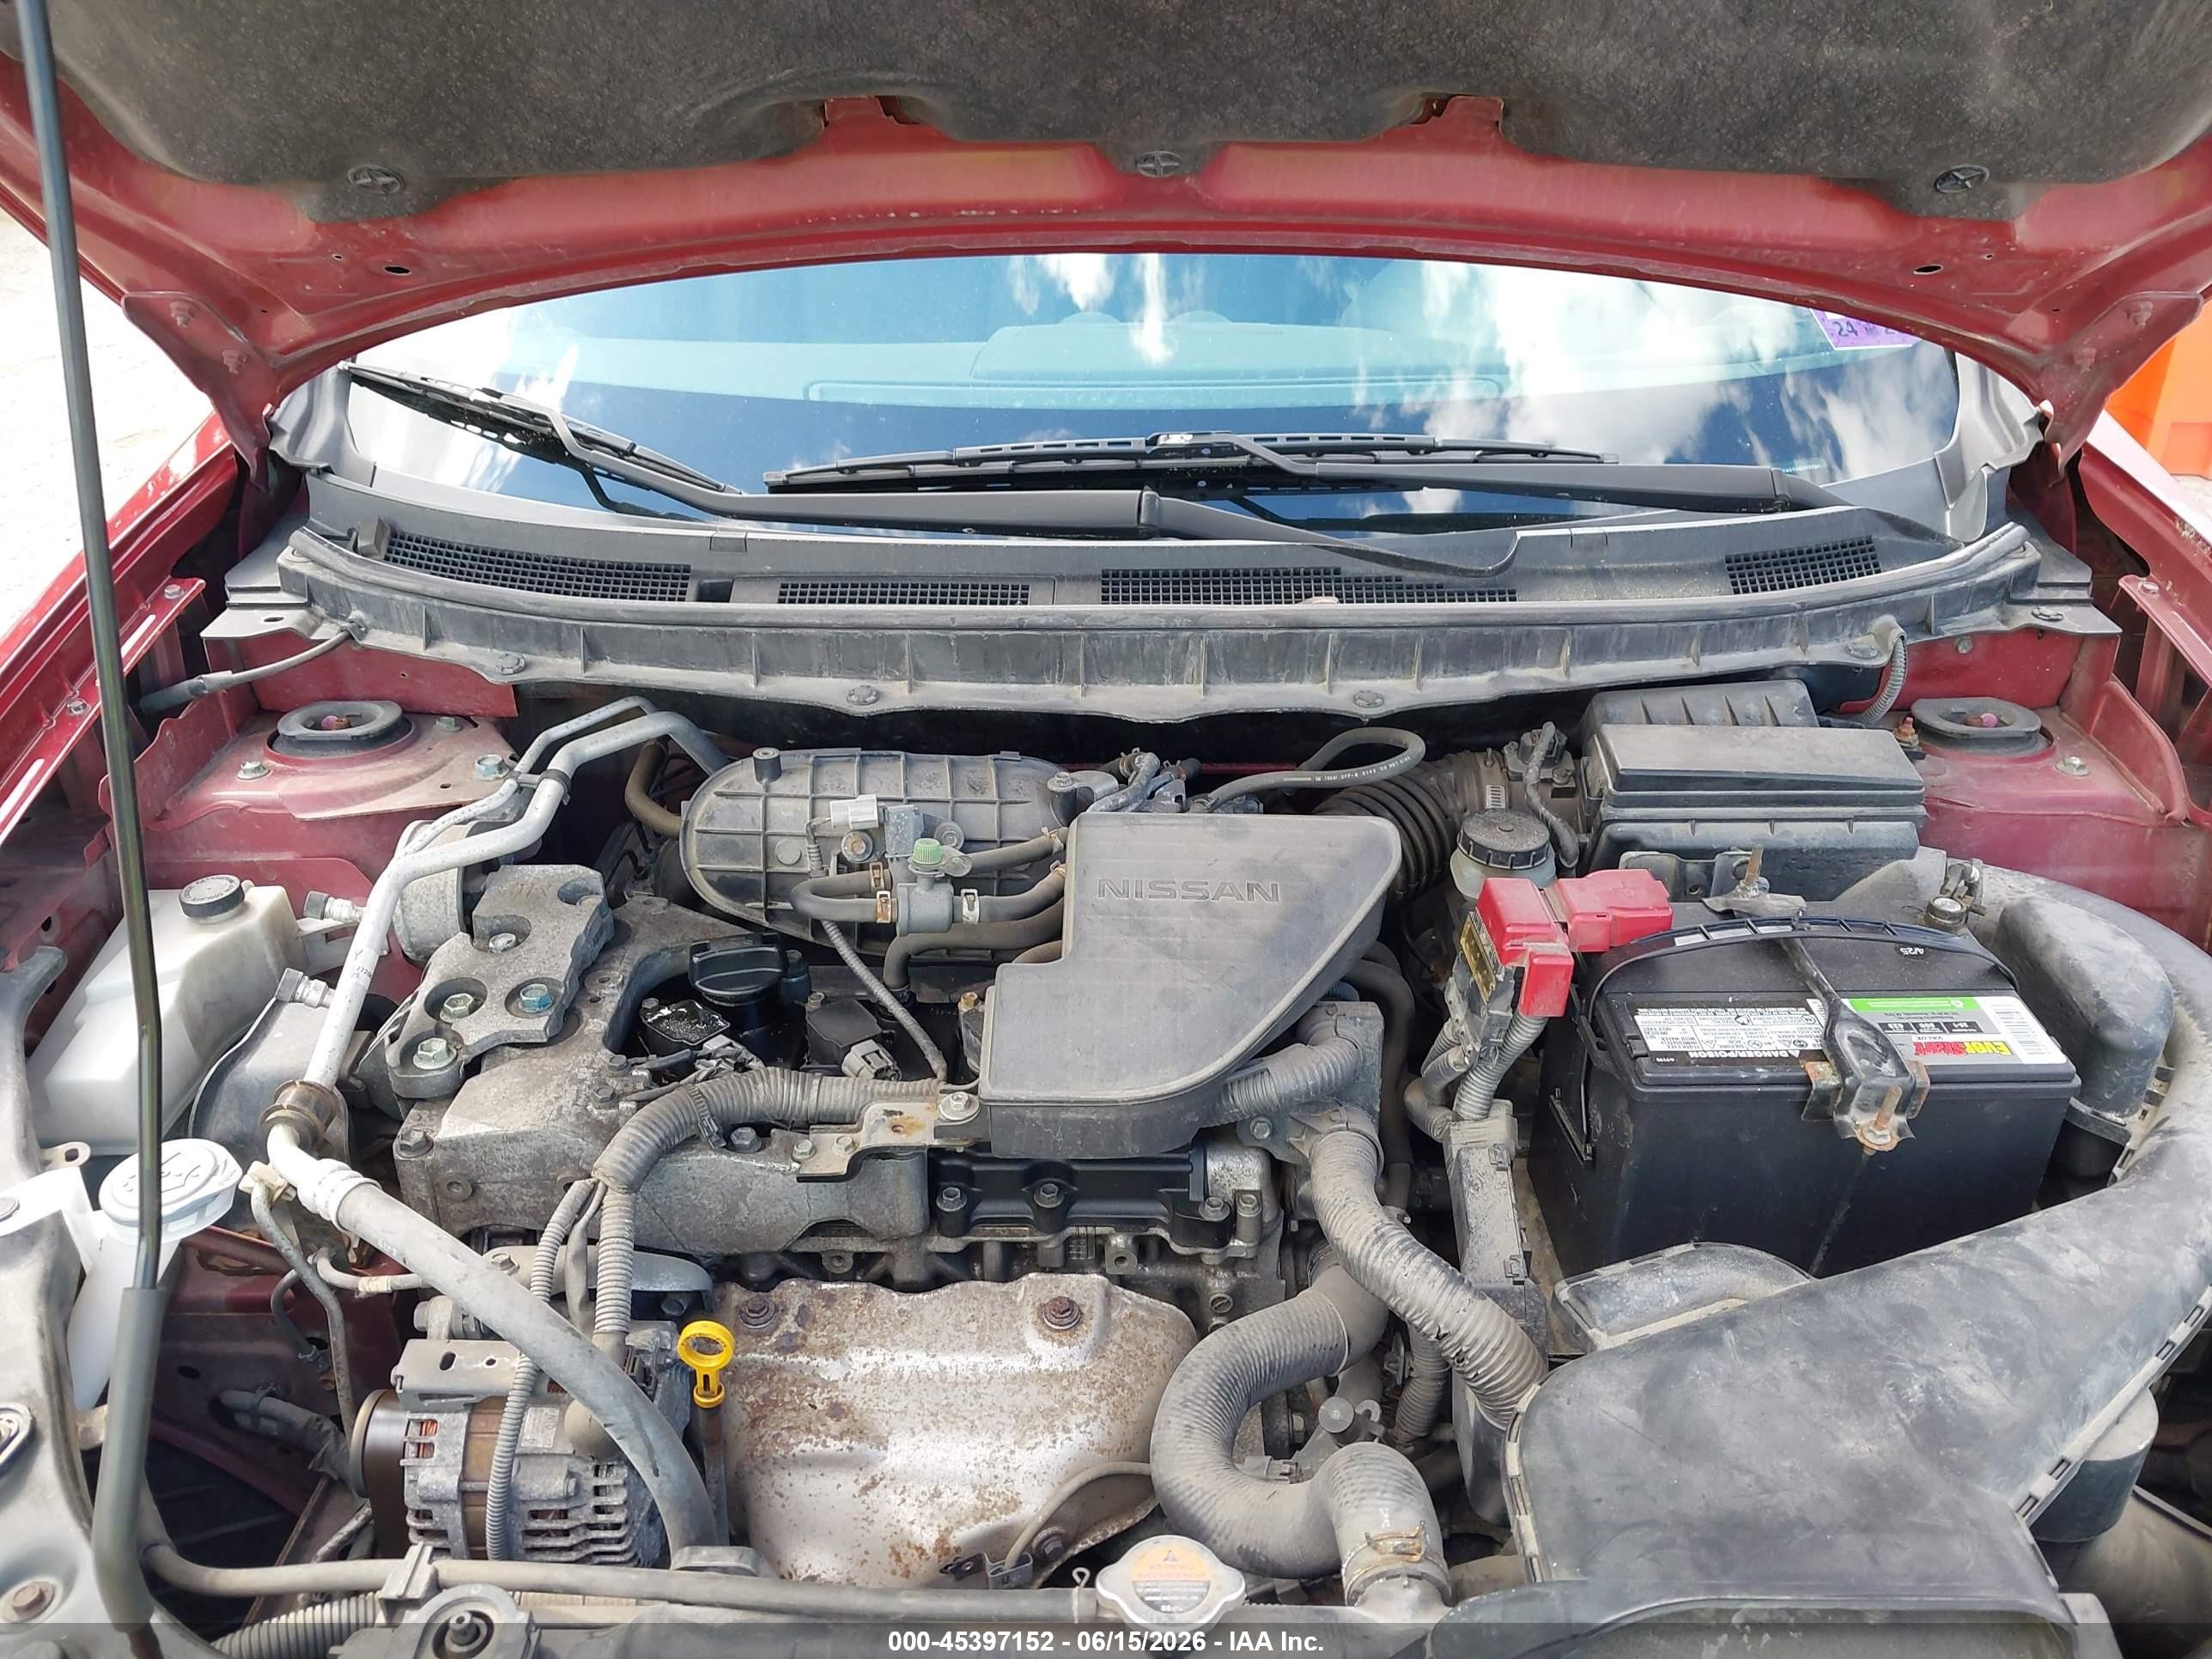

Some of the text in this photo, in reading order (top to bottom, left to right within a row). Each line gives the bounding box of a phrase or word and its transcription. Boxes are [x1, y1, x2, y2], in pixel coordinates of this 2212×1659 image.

[1832, 320, 1859, 337] 24
[1097, 878, 1280, 903] NISSAN
[1899, 947, 1924, 956] 4/25
[1913, 1041, 2014, 1056] EverStart
